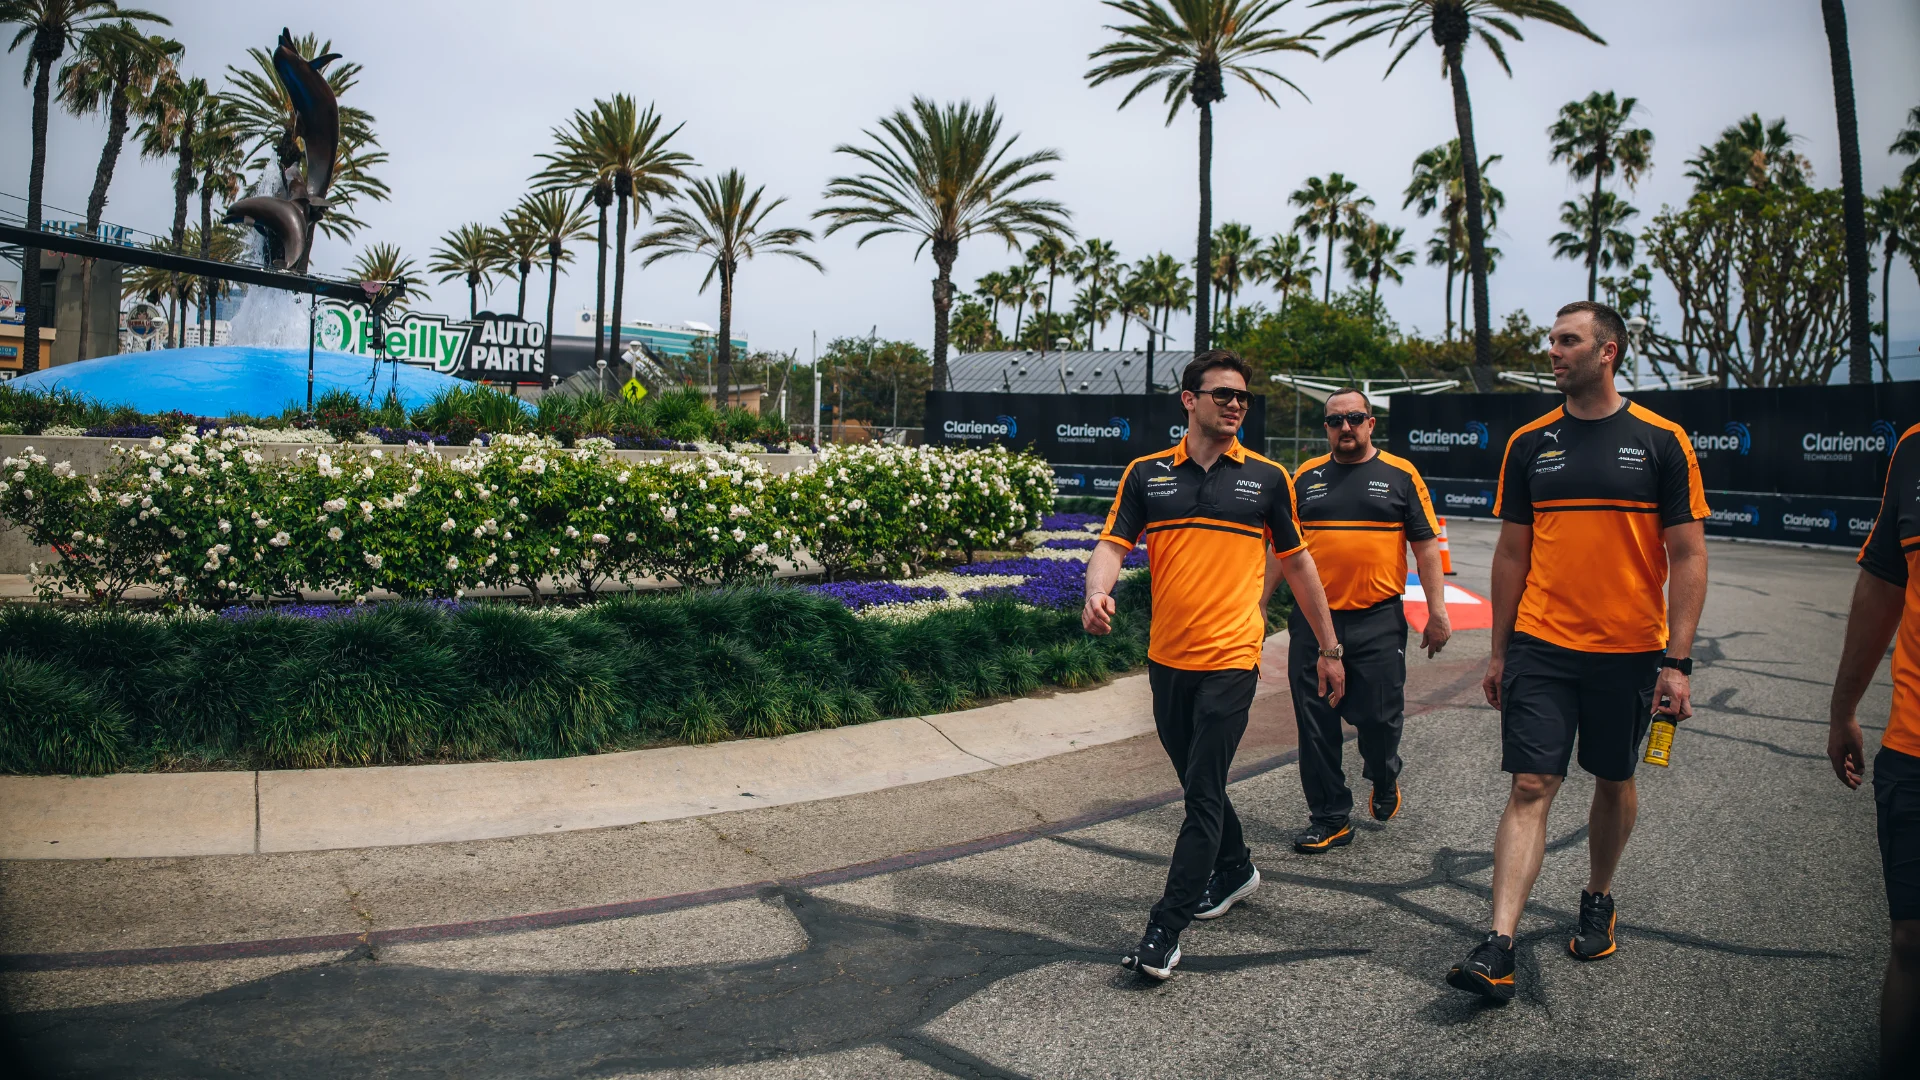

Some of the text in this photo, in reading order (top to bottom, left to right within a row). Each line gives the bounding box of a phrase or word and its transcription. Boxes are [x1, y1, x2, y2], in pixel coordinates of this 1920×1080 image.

[97, 223, 134, 248] IKE
[479, 319, 545, 348] AUTO
[471, 345, 545, 374] PARTS
[943, 420, 1008, 435] Clarience
[1056, 423, 1121, 438] Clarience
[1409, 428, 1479, 445] Clarience
[1802, 431, 1886, 452] Clarience
[1445, 493, 1488, 505] Clarience
[1782, 513, 1830, 529] Clarience
